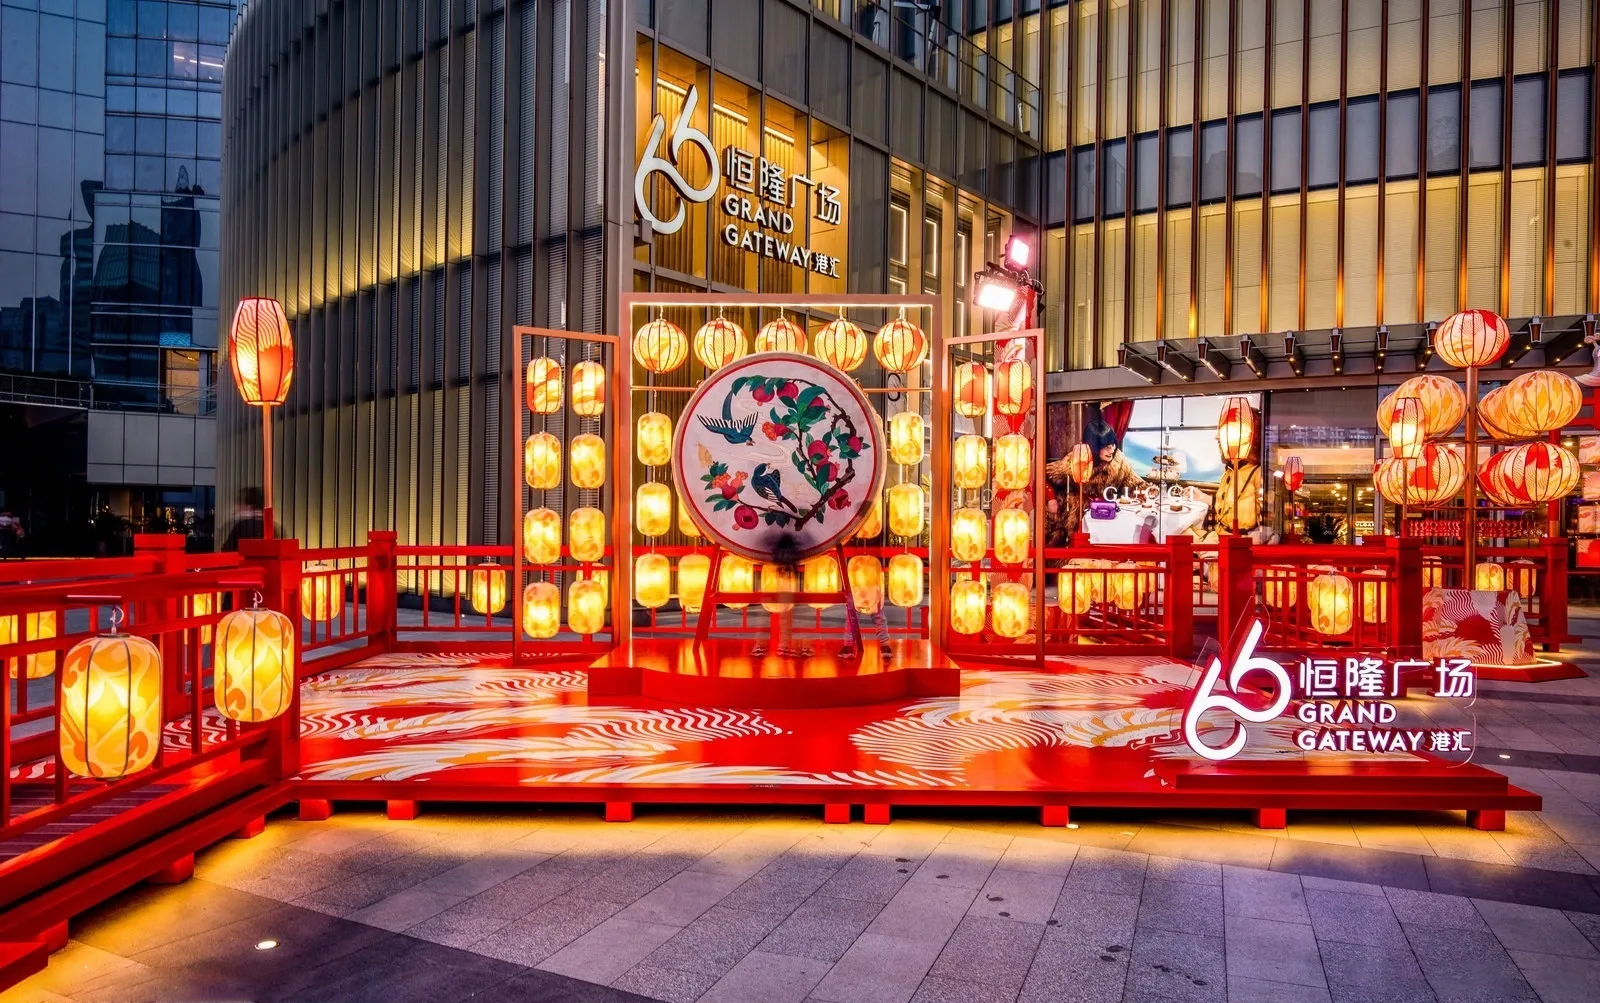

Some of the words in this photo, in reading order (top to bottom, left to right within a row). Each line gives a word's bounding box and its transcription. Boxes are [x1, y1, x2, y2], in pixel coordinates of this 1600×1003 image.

[725, 144, 841, 225] 恒隆广场
[725, 193, 794, 234] GRAND
[725, 223, 811, 268] GATEWAY
[814, 252, 841, 279] 港汇
[1102, 486, 1195, 502] GUCCI
[1299, 657, 1474, 698] 恒隆广场
[1298, 702, 1397, 724] GRAND
[1297, 730, 1423, 752] GATEWAY
[1430, 731, 1473, 752] 港汇
